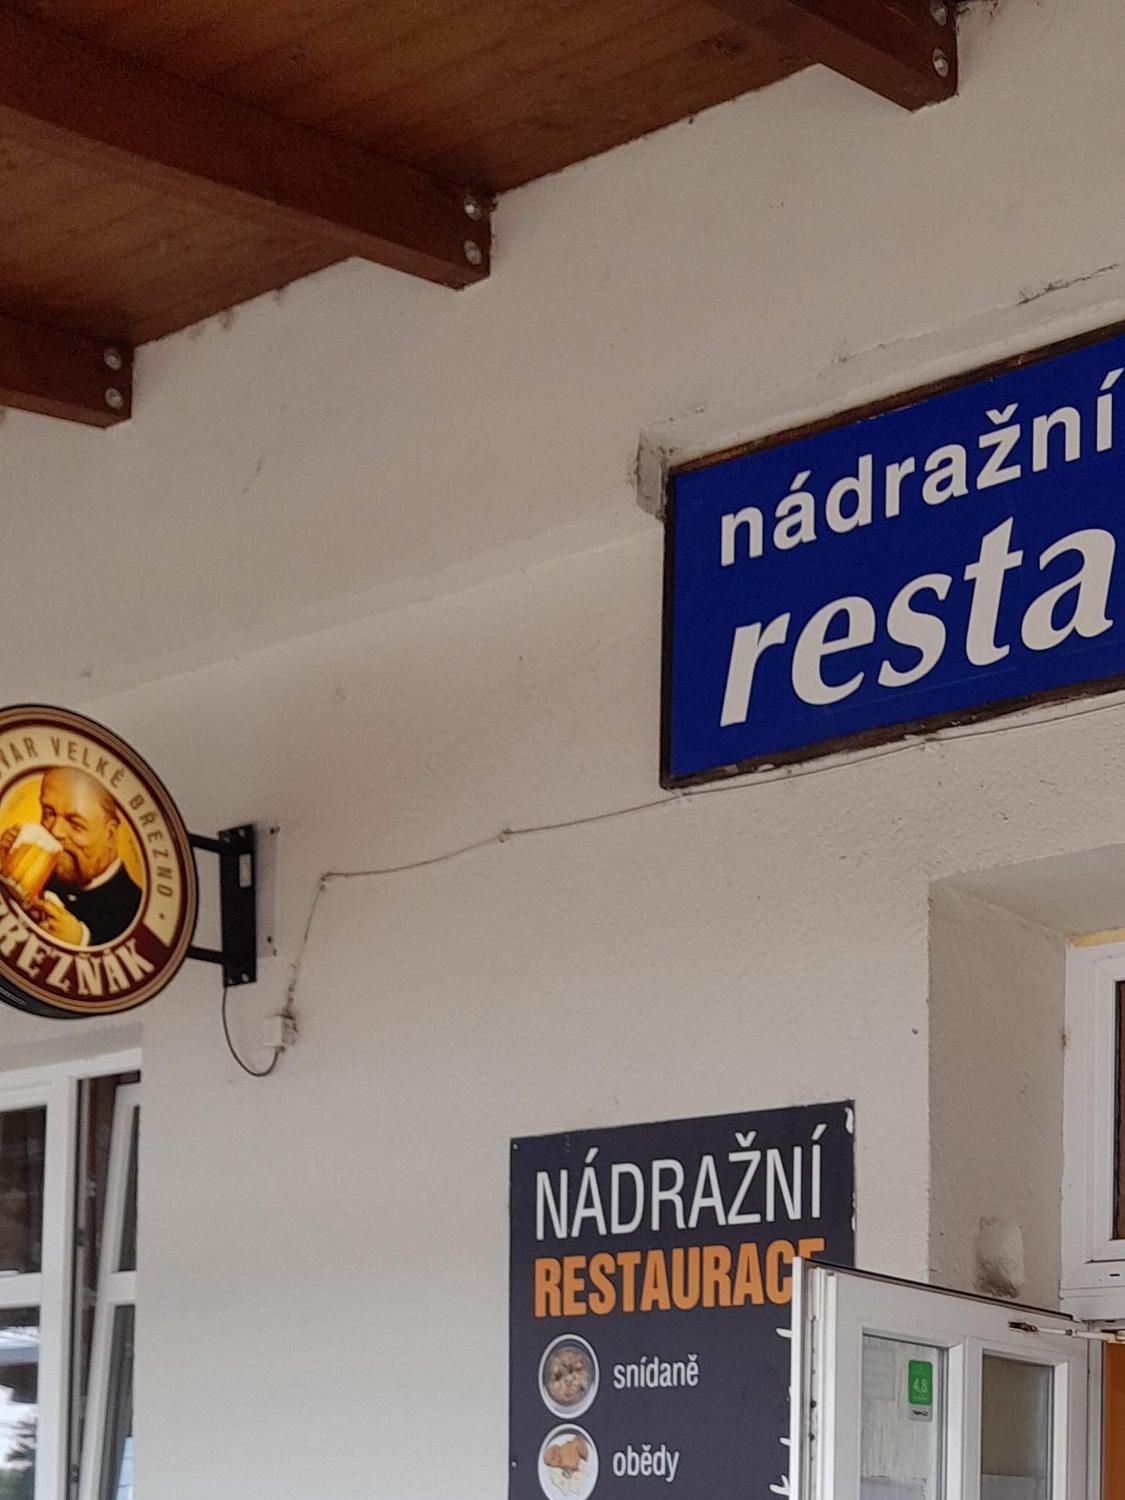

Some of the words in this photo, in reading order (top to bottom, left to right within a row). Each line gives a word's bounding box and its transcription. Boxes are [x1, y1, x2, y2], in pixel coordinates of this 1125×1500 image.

[721, 367, 1125, 566] nádražní
[50, 735, 126, 790] VELKÉ
[535, 1123, 828, 1241] NÁDRAŽNÍ
[534, 1237, 826, 1318] RESTAURAC
[612, 1354, 699, 1389] snídaně
[612, 1444, 681, 1482] obědy
